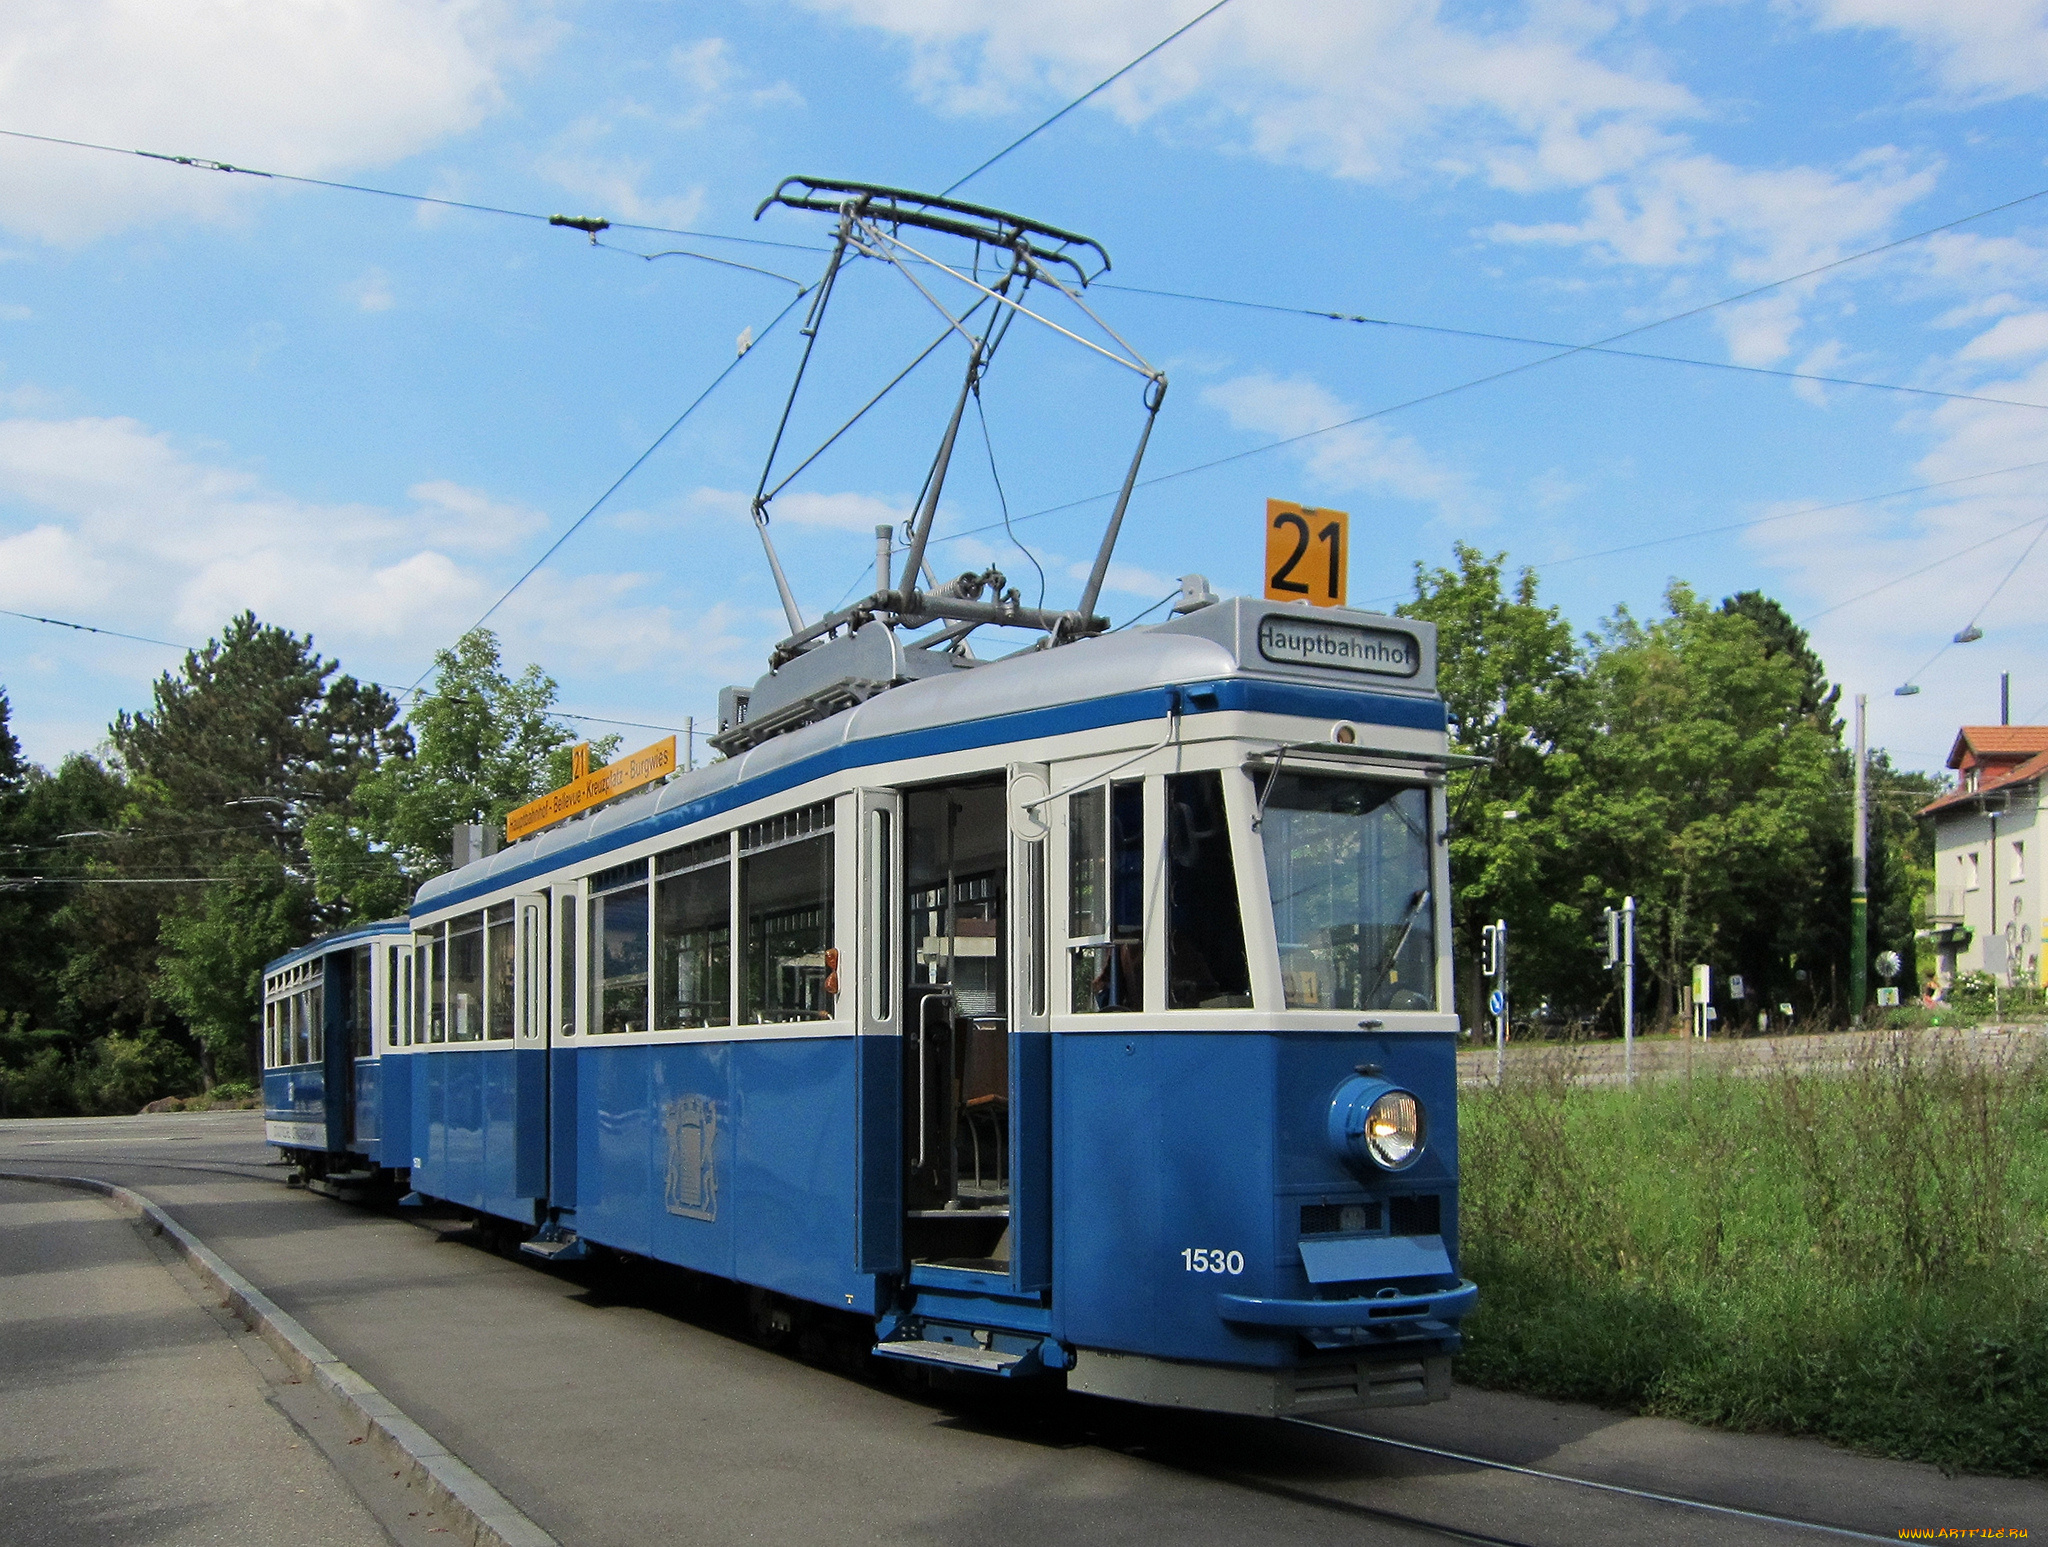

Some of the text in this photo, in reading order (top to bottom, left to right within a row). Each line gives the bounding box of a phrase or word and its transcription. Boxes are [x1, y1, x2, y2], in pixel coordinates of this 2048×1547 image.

[1271, 512, 1340, 599] 21
[1260, 626, 1411, 665] Hauptbahnhof
[553, 790, 581, 813] Bellevue
[586, 770, 623, 799] Kreuzplatz
[630, 749, 669, 779] Burgwies
[574, 749, 584, 779] 21
[1180, 1247, 1245, 1275] 1530
